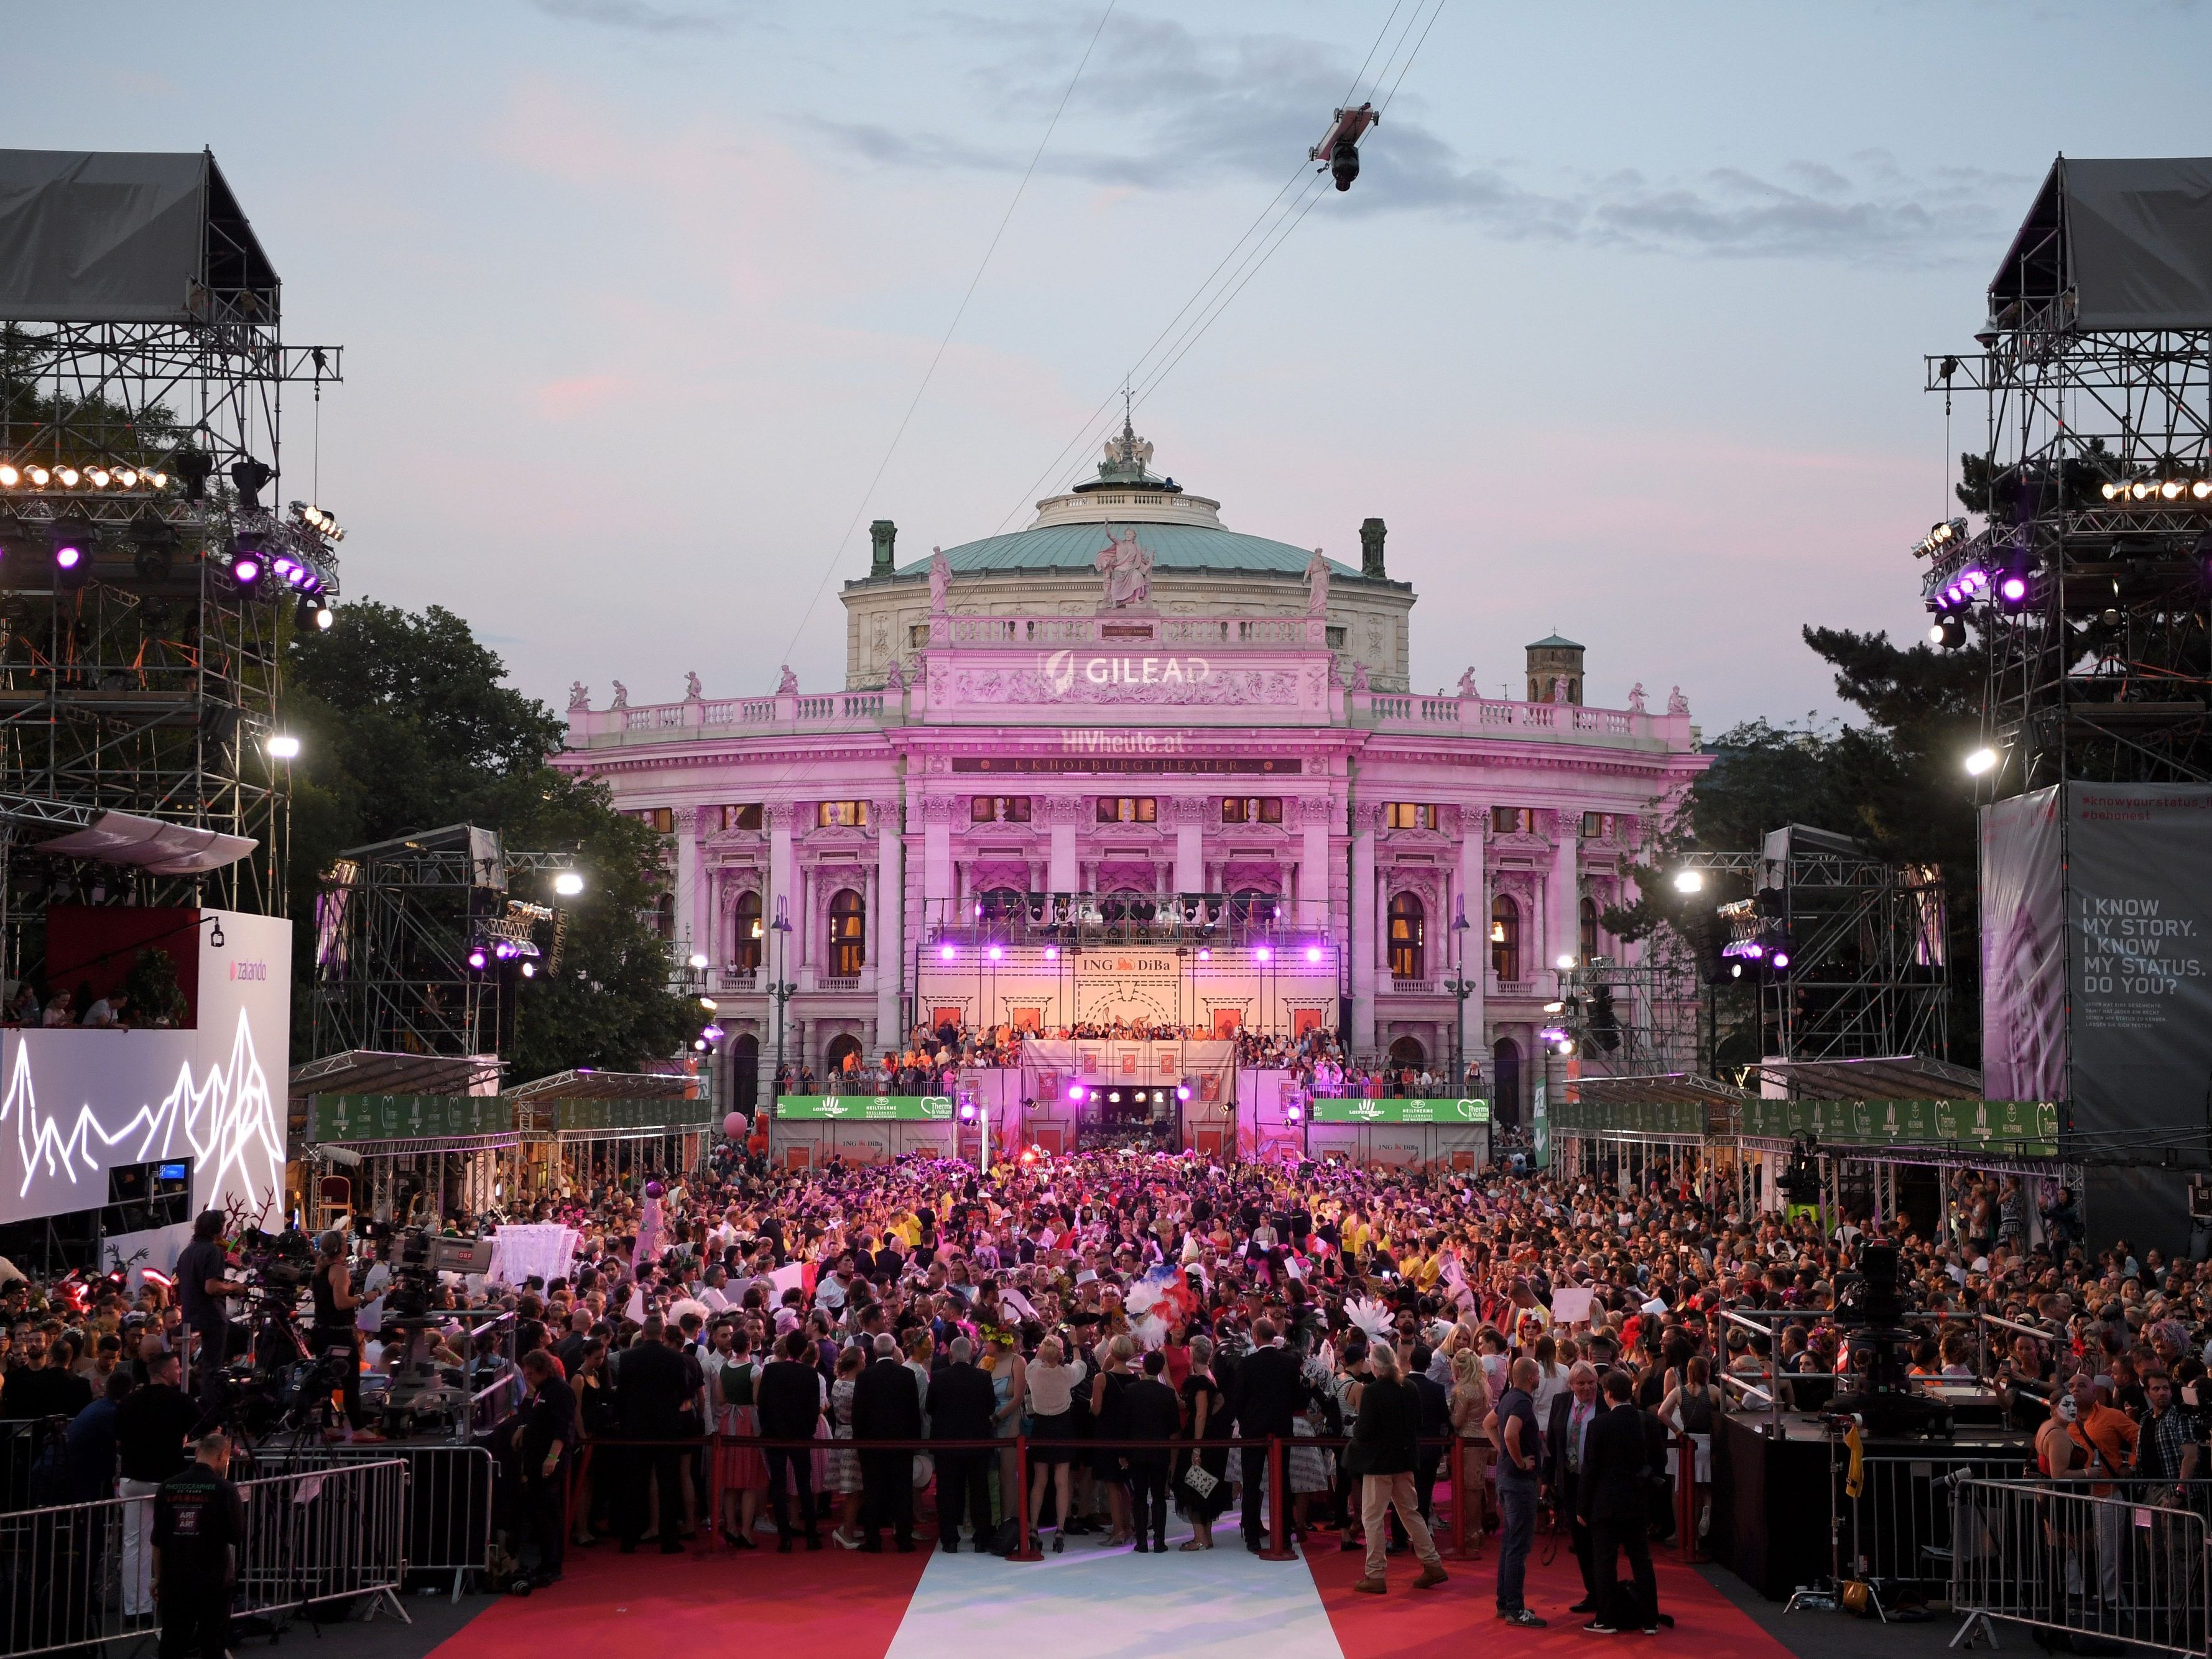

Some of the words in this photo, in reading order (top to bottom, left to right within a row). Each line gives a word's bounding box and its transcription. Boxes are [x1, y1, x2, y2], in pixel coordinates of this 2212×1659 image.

[1086, 658, 1209, 683] GILEAD
[1062, 731, 1185, 753] HIVheute.at
[2082, 811, 2150, 820] #behonest
[2083, 898, 2086, 914] I
[2096, 899, 2159, 916] KNOW
[2083, 918, 2113, 935] MY
[2121, 919, 2196, 936] STORY.
[2085, 937, 2088, 953] I
[2098, 937, 2160, 955] KNOW
[238, 958, 266, 981] zalando
[1083, 959, 1113, 970] ING
[1138, 959, 1170, 970] DiBa
[2085, 956, 2114, 973] MY
[2122, 958, 2206, 976] STATUS.
[2085, 976, 2113, 993] DO
[2121, 977, 2177, 994] YOU?
